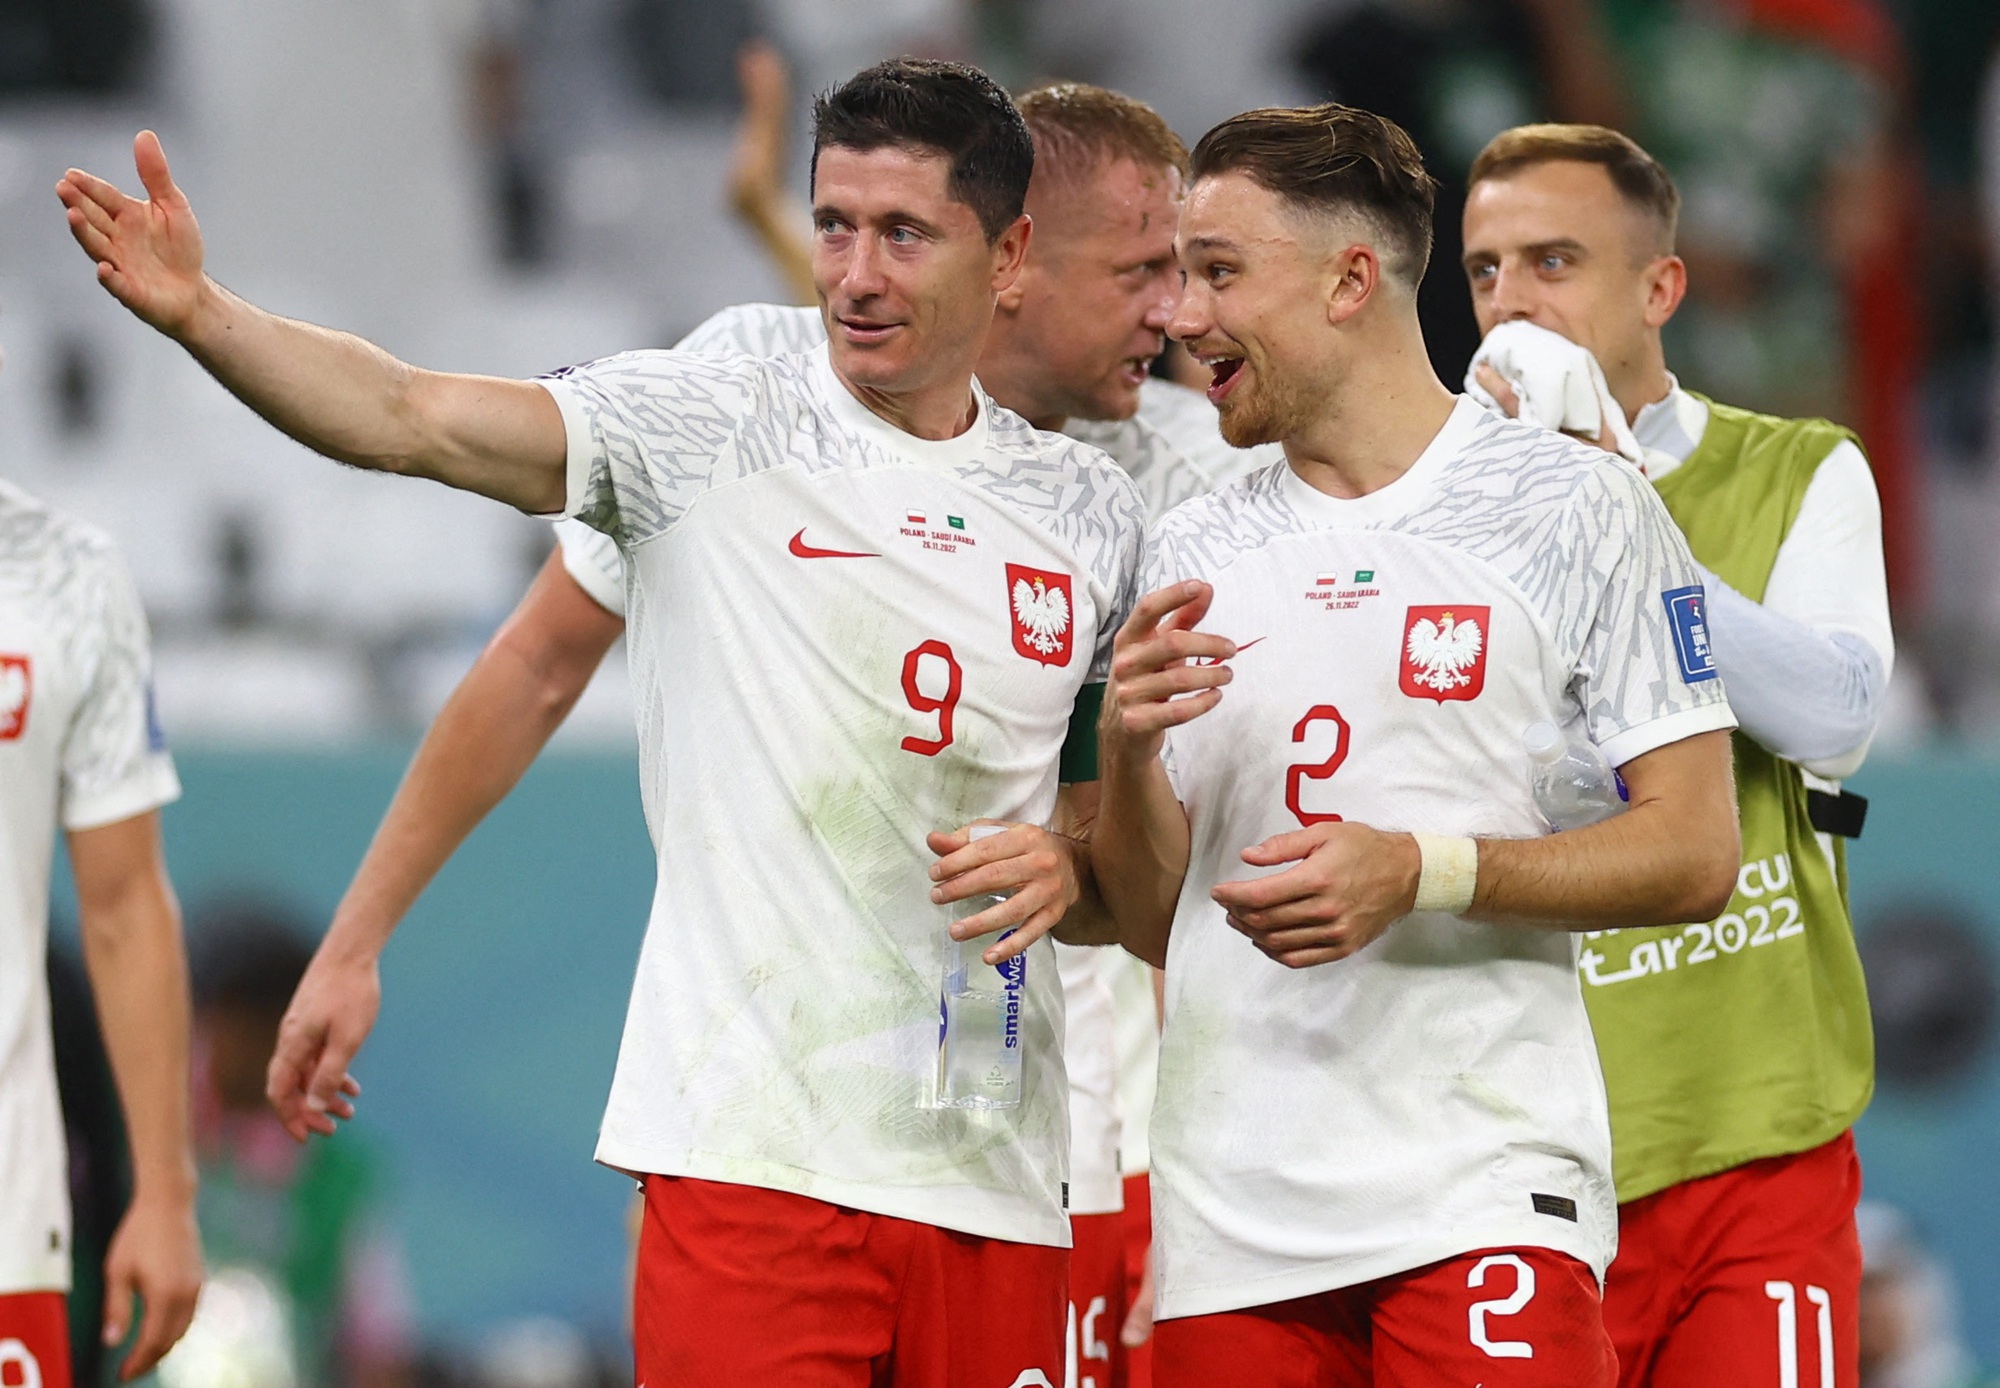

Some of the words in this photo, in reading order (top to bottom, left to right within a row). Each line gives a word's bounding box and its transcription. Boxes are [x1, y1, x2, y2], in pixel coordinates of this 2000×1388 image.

[899, 527, 926, 537] POLAND
[931, 531, 952, 541] SAUDI
[953, 534, 976, 546] ARABIA
[922, 540, 957, 553] 26.11.2022
[1325, 601, 1359, 610] 26.11.2022
[1337, 590, 1356, 599] SAUDI
[901, 639, 962, 757] 9
[1285, 704, 1351, 828] 2
[1738, 853, 1792, 898] CU
[1466, 1253, 1536, 1359] 2
[1764, 1280, 1836, 1388] 11
